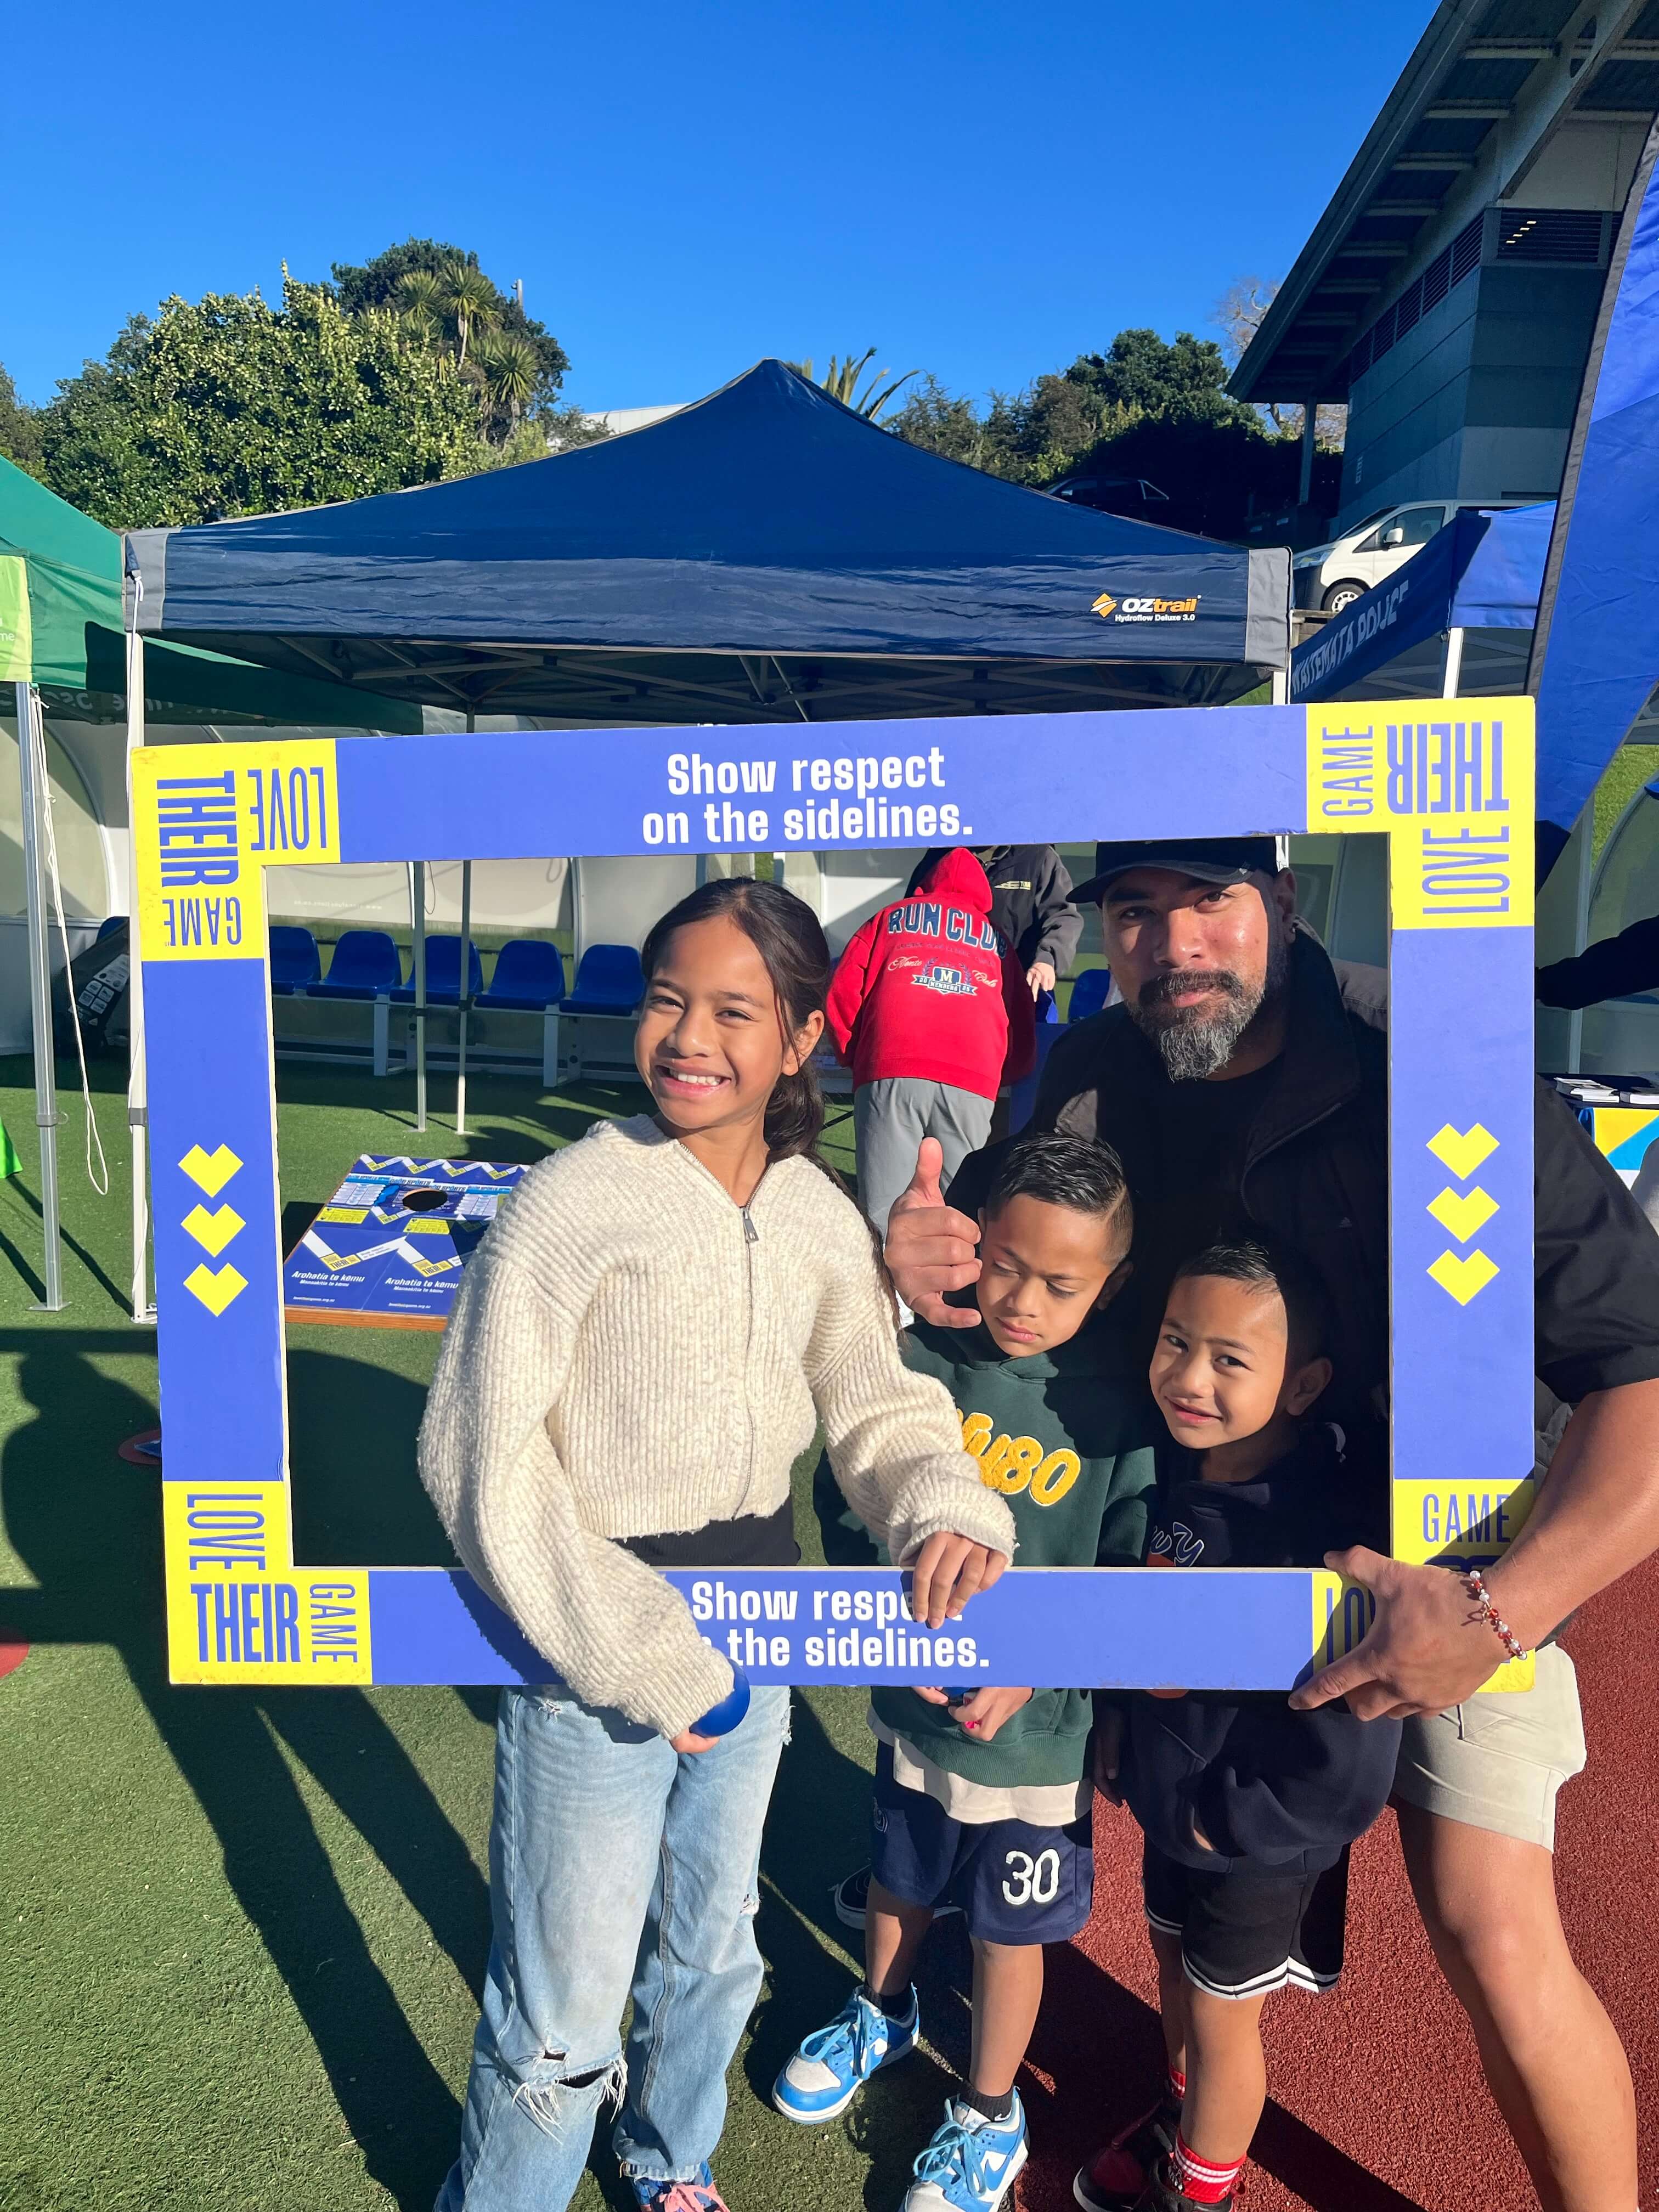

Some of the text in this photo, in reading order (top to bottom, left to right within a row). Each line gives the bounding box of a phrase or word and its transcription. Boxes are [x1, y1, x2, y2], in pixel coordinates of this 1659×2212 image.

[1122, 598, 1197, 613] OZtrail
[1292, 620, 1355, 695] WAITEMATA
[667, 747, 945, 799] Show respect
[1322, 725, 1374, 817] GAME
[1387, 720, 1510, 814] THEIR
[156, 770, 239, 888] THEIR
[247, 766, 326, 851] LOVE
[642, 797, 974, 844] on the sidelines.
[1423, 825, 1510, 914] LOVE
[162, 896, 242, 946] GAME
[888, 903, 943, 938] RUN
[940, 969, 952, 983] M
[187, 1494, 266, 1571] LOVE
[1423, 1493, 1511, 1543] GAME
[190, 1583, 301, 1663] THEIR
[309, 1583, 358, 1663] GAME
[691, 1581, 798, 1621] Show
[727, 1627, 990, 1668] the sidelines.
[1001, 1848, 1061, 1906] 30
